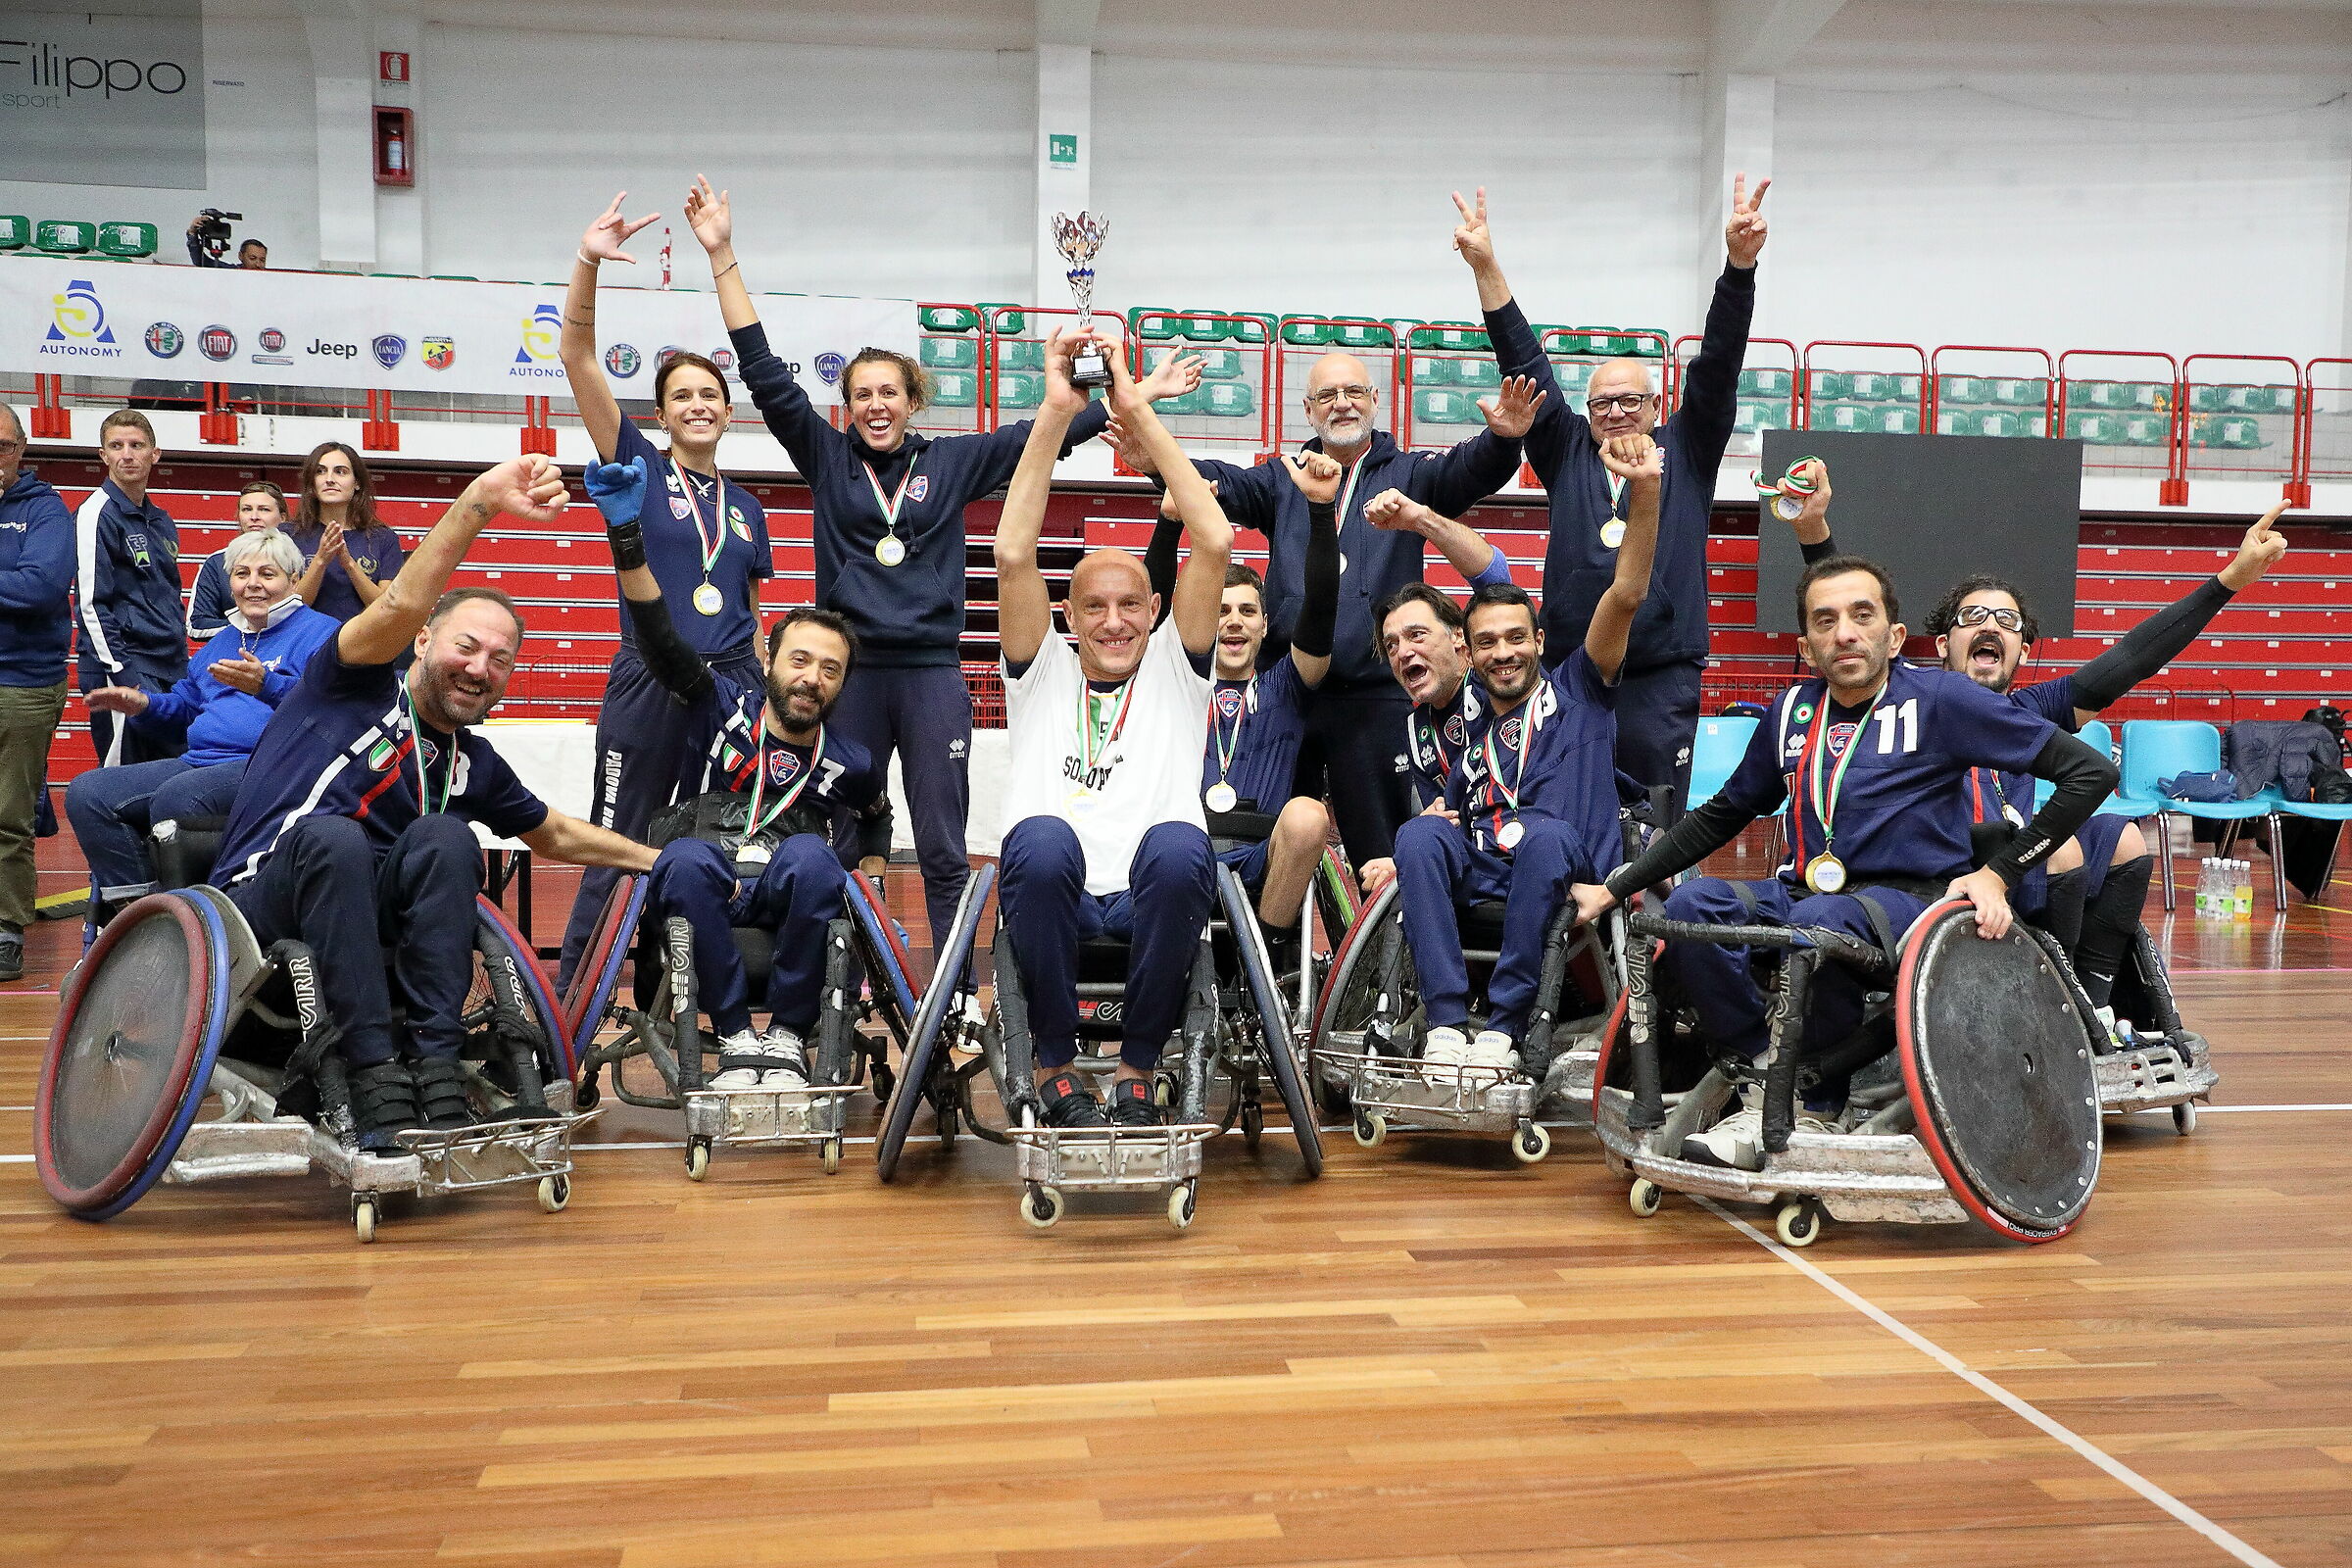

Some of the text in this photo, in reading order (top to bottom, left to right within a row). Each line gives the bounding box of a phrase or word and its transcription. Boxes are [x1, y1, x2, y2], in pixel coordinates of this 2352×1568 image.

[208, 336, 230, 353] FIAT
[266, 334, 281, 346] FIAT
[40, 345, 122, 357] AUTONOMY
[307, 338, 358, 359] Jeep
[377, 346, 401, 355] LANCIA
[715, 354, 731, 365] FIAT
[510, 368, 564, 377] AUTONO
[1874, 698, 1918, 754] 11
[817, 758, 846, 797] 7
[601, 750, 622, 830] PADOVA RU
